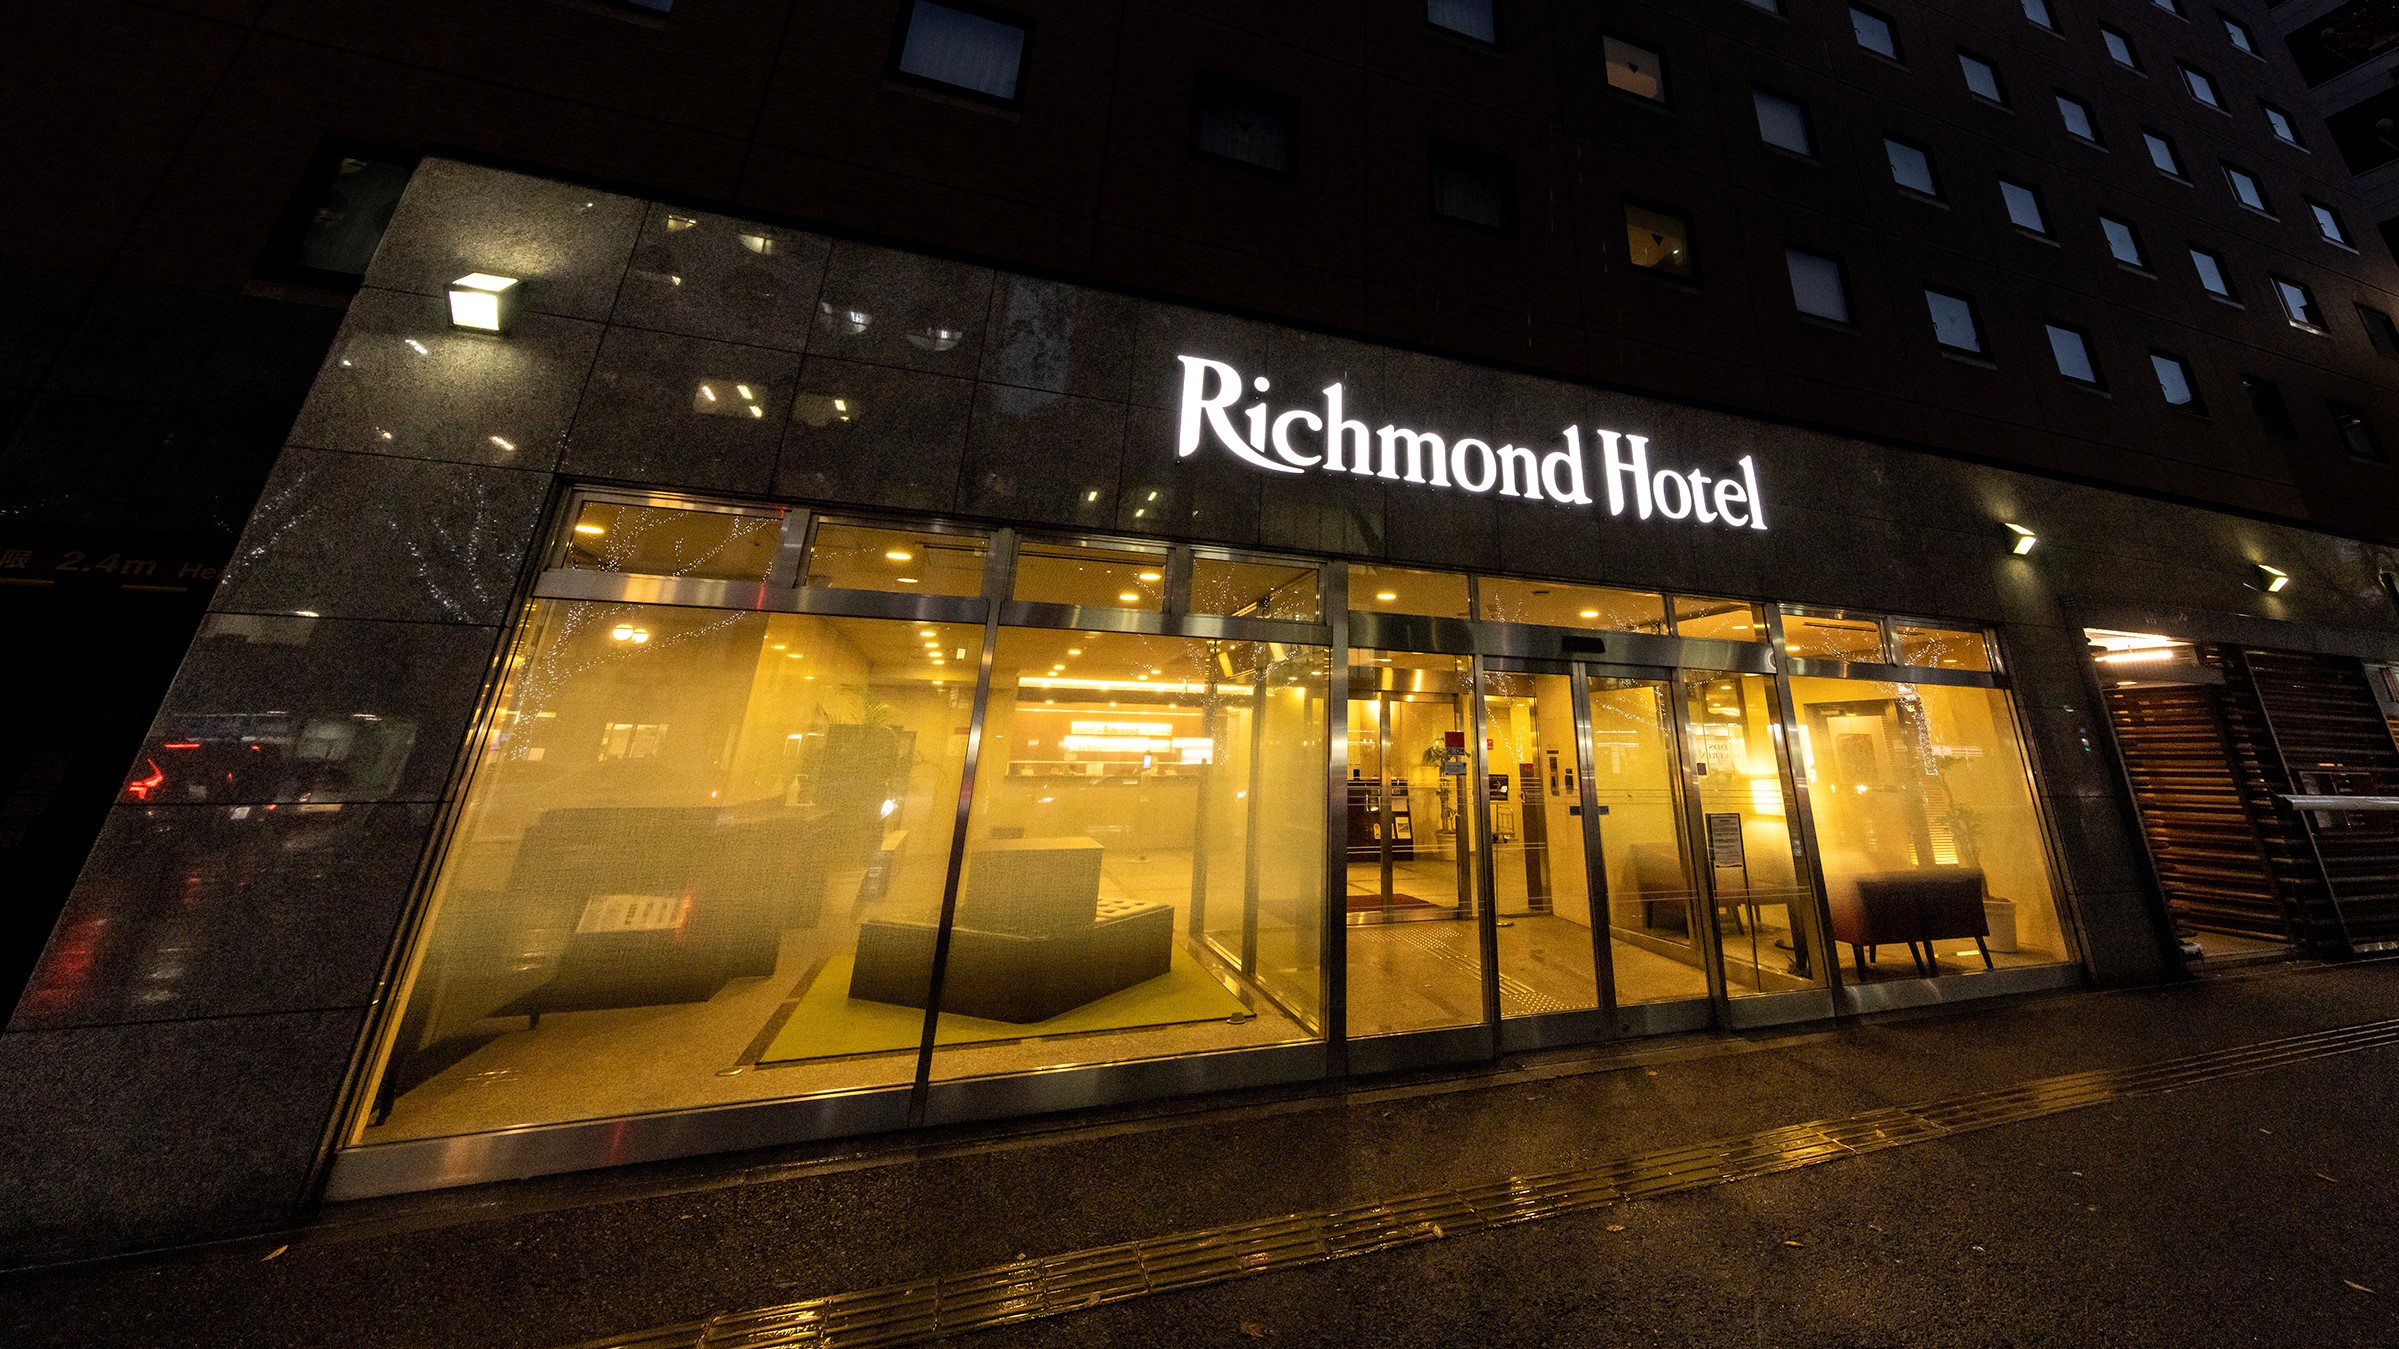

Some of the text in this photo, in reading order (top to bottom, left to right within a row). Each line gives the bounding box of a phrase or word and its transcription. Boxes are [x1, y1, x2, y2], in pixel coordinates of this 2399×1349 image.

[1177, 354, 1768, 530] Richmond Hotel
[56, 550, 157, 576] 2.4m
